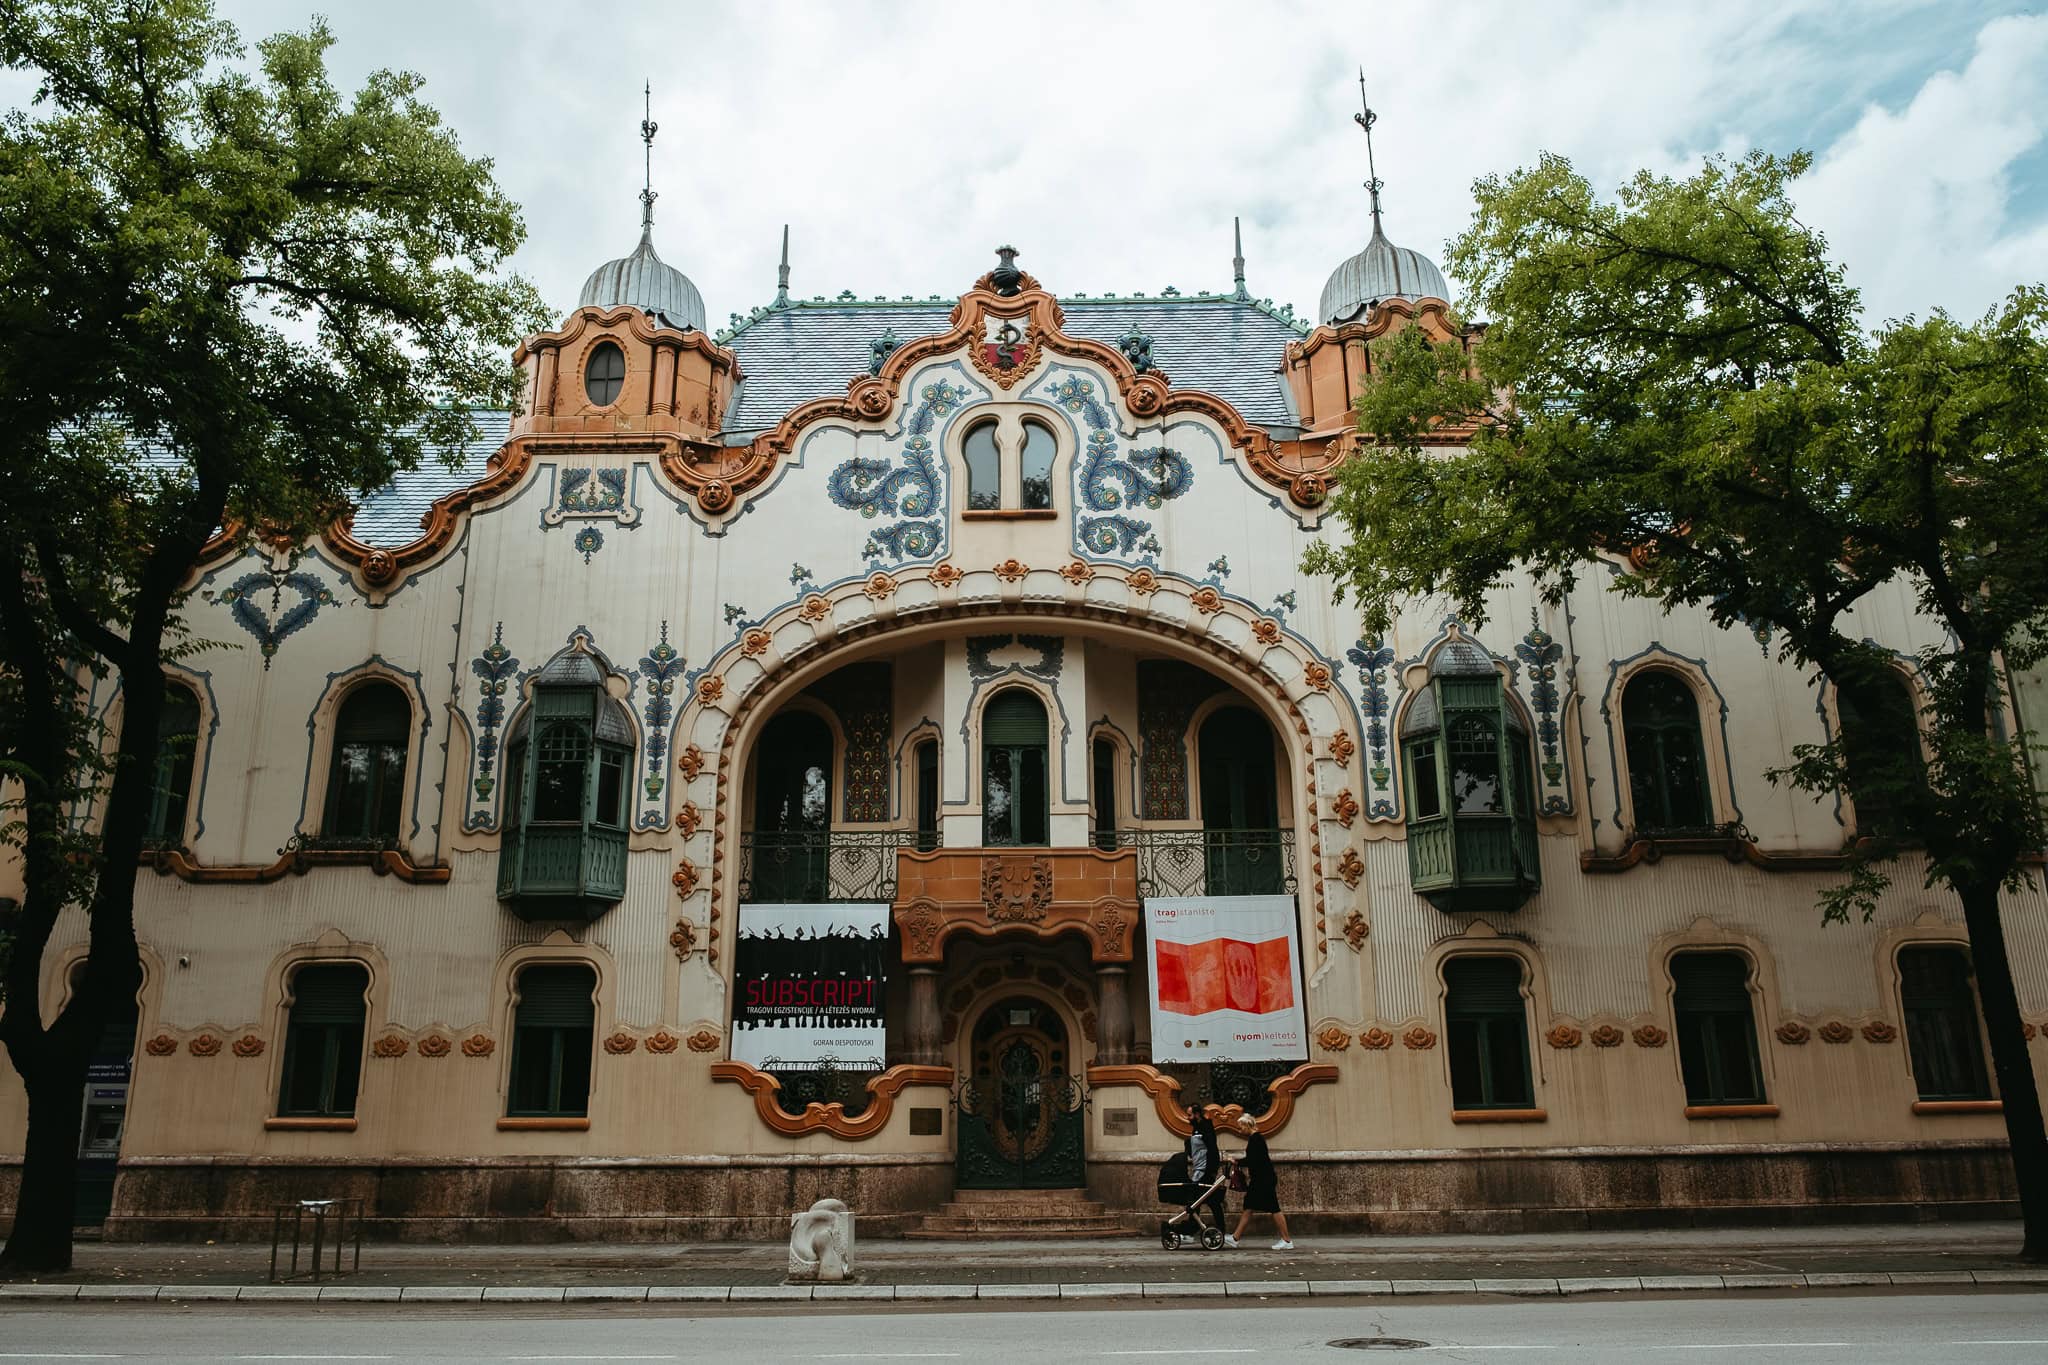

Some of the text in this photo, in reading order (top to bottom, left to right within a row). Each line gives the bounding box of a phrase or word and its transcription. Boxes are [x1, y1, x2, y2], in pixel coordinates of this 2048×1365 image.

[746, 979, 876, 1006] SUBSCRIPT
[746, 1006, 773, 1014] TRAGOVI
[773, 1006, 813, 1014] EGZISTENCIJE
[819, 1006, 824, 1014] A
[851, 1006, 876, 1014] NYOMAI
[813, 1039, 874, 1047] GORAN DESPOTOVSKI
